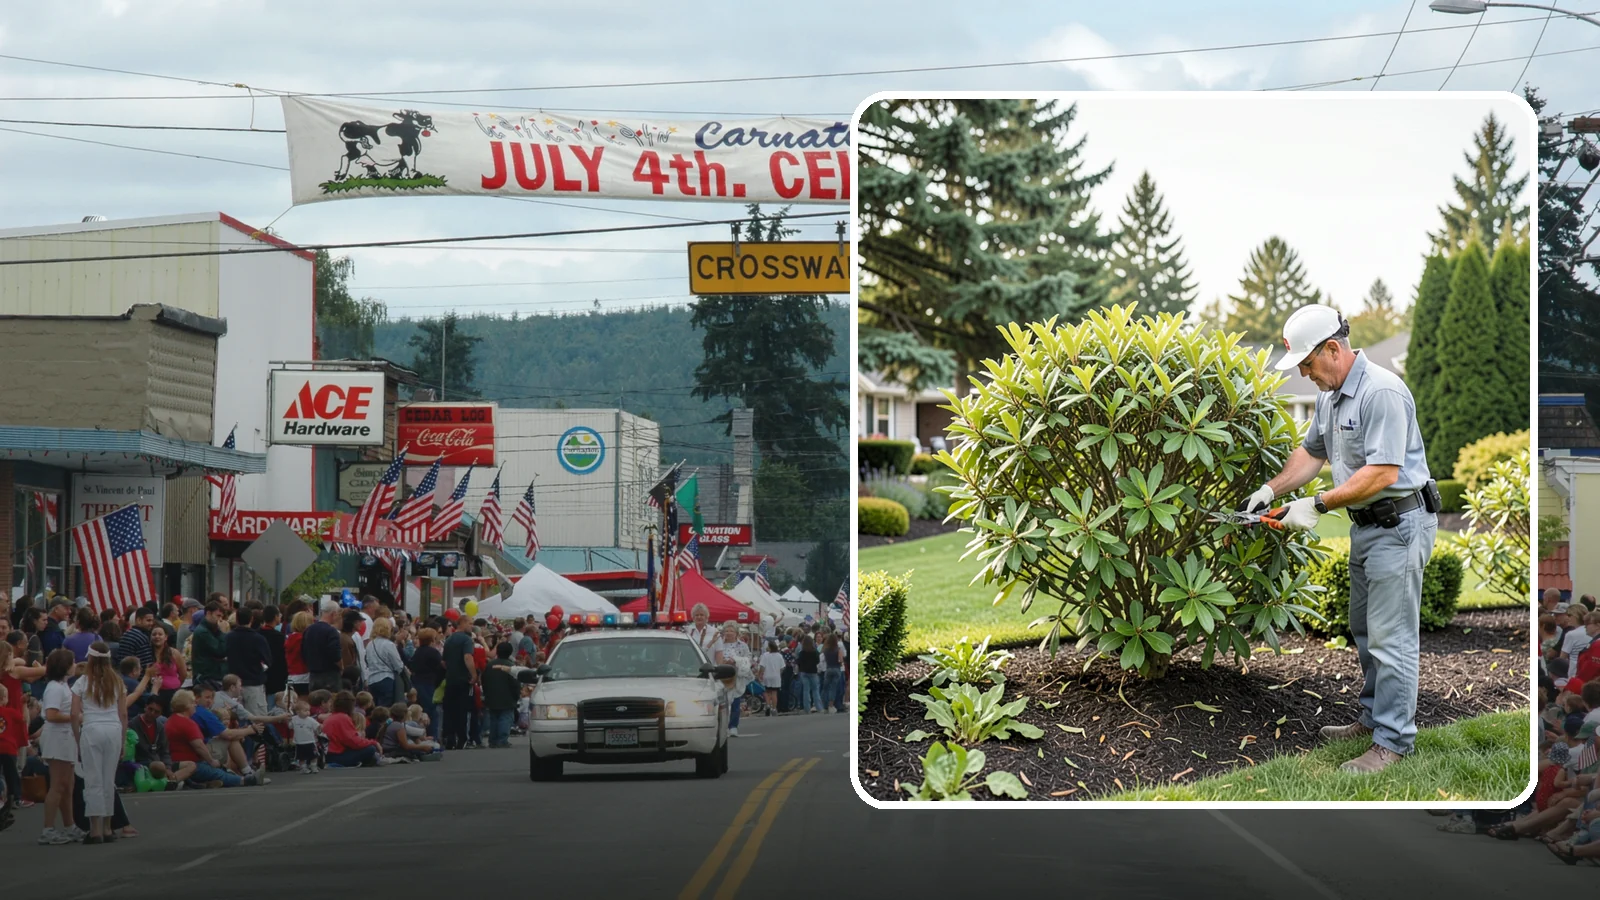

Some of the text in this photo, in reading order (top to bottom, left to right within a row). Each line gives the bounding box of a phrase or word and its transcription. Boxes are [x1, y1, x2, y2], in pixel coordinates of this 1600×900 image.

[481, 140, 605, 192] JULY
[632, 150, 747, 198] 4th.
[696, 254, 851, 280] CROSSWA
[282, 380, 374, 420] ACE
[405, 409, 485, 422] CEDAR LOG
[283, 421, 371, 436] Hardware
[416, 428, 477, 447] Coca-Cola
[353, 467, 386, 480] Simpl
[95, 485, 124, 495] Vincent
[126, 486, 136, 495] de
[137, 486, 155, 495] Paul
[688, 526, 742, 535] CRNATION
